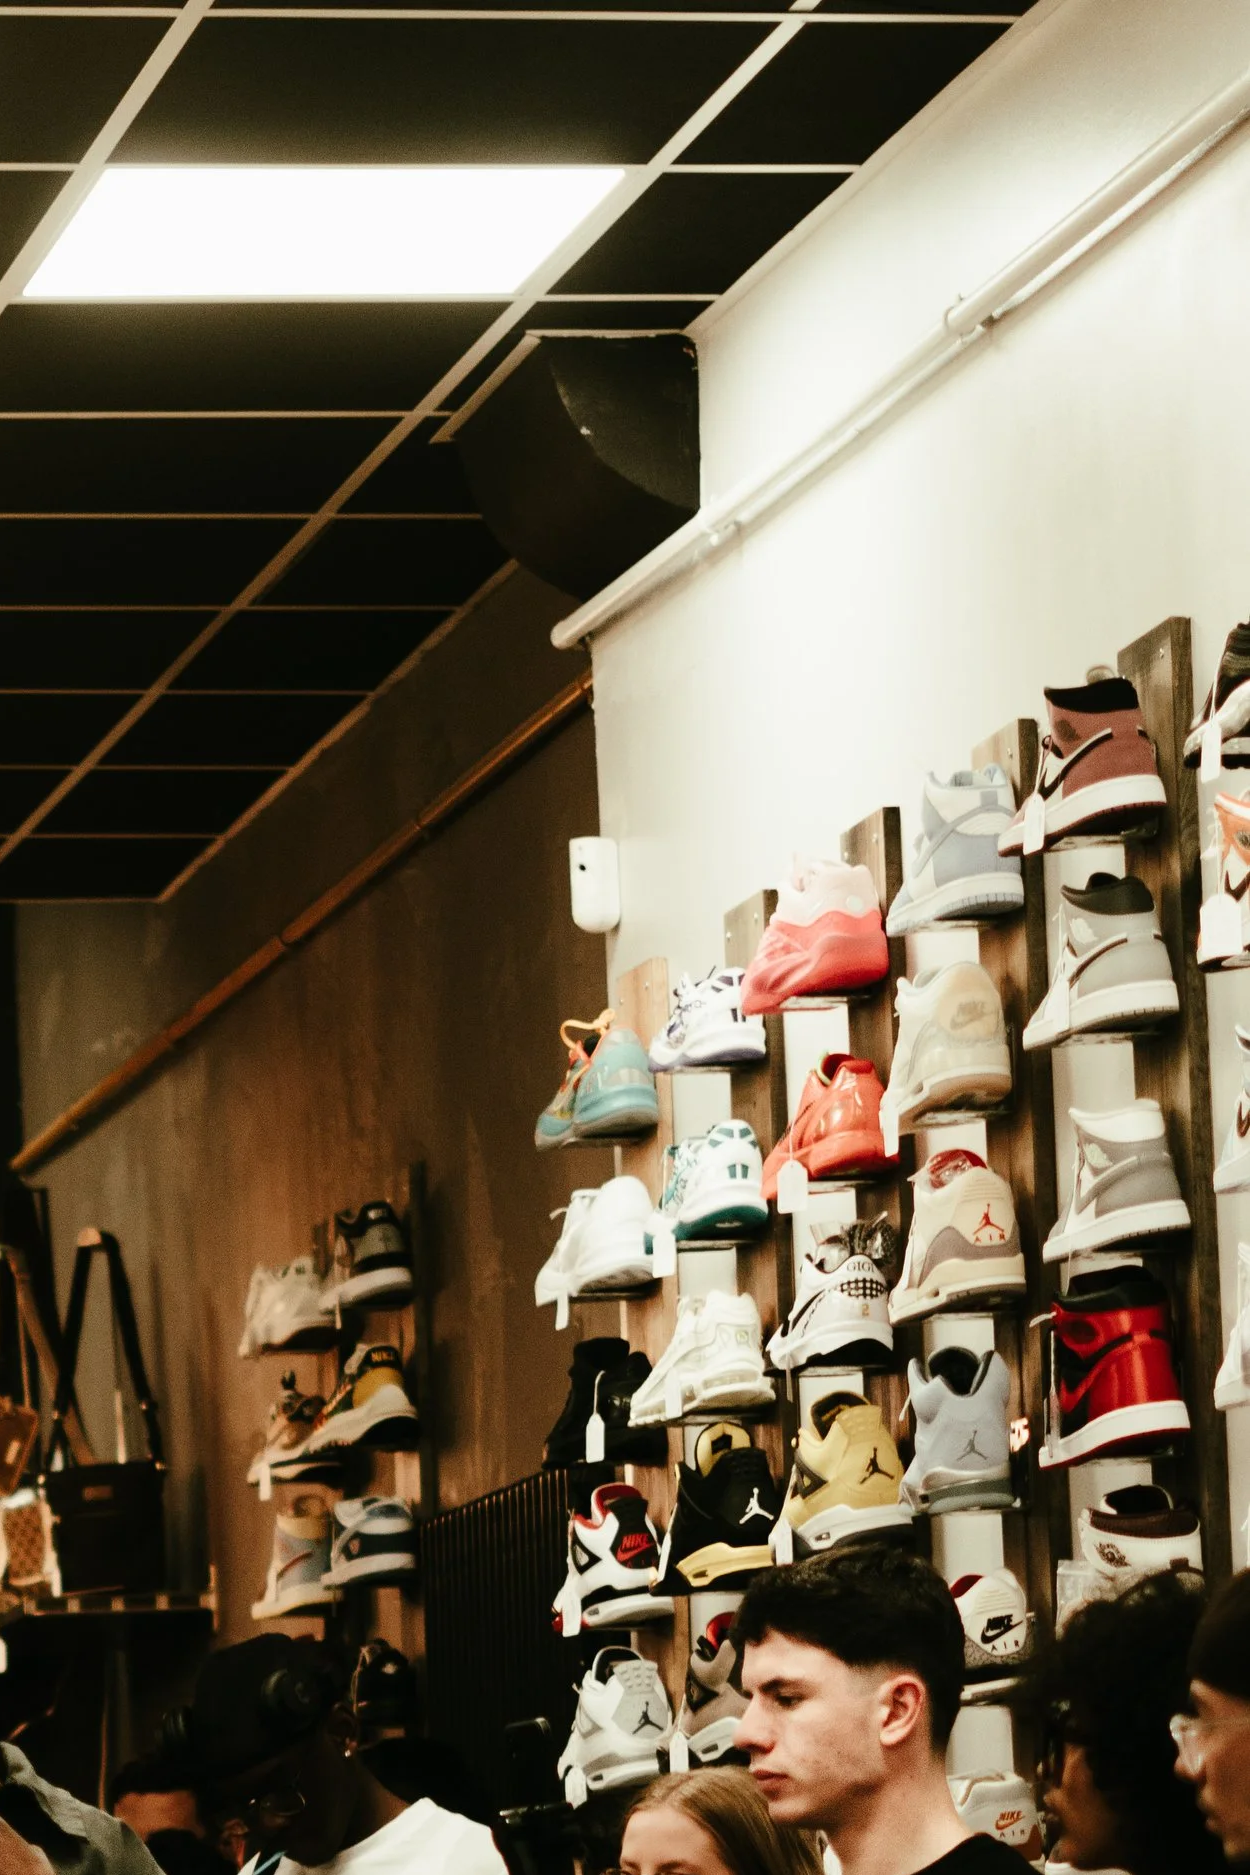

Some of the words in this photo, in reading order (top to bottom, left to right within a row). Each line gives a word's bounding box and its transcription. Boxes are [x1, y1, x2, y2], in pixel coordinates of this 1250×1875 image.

[974, 1233, 1006, 1243] AIR
[621, 1532, 650, 1550] NIKE
[985, 1613, 1014, 1633] NIKE
[991, 1639, 1020, 1652] AIR
[999, 1810, 1023, 1821] NIKE
[1000, 1829, 1026, 1838] AIR
